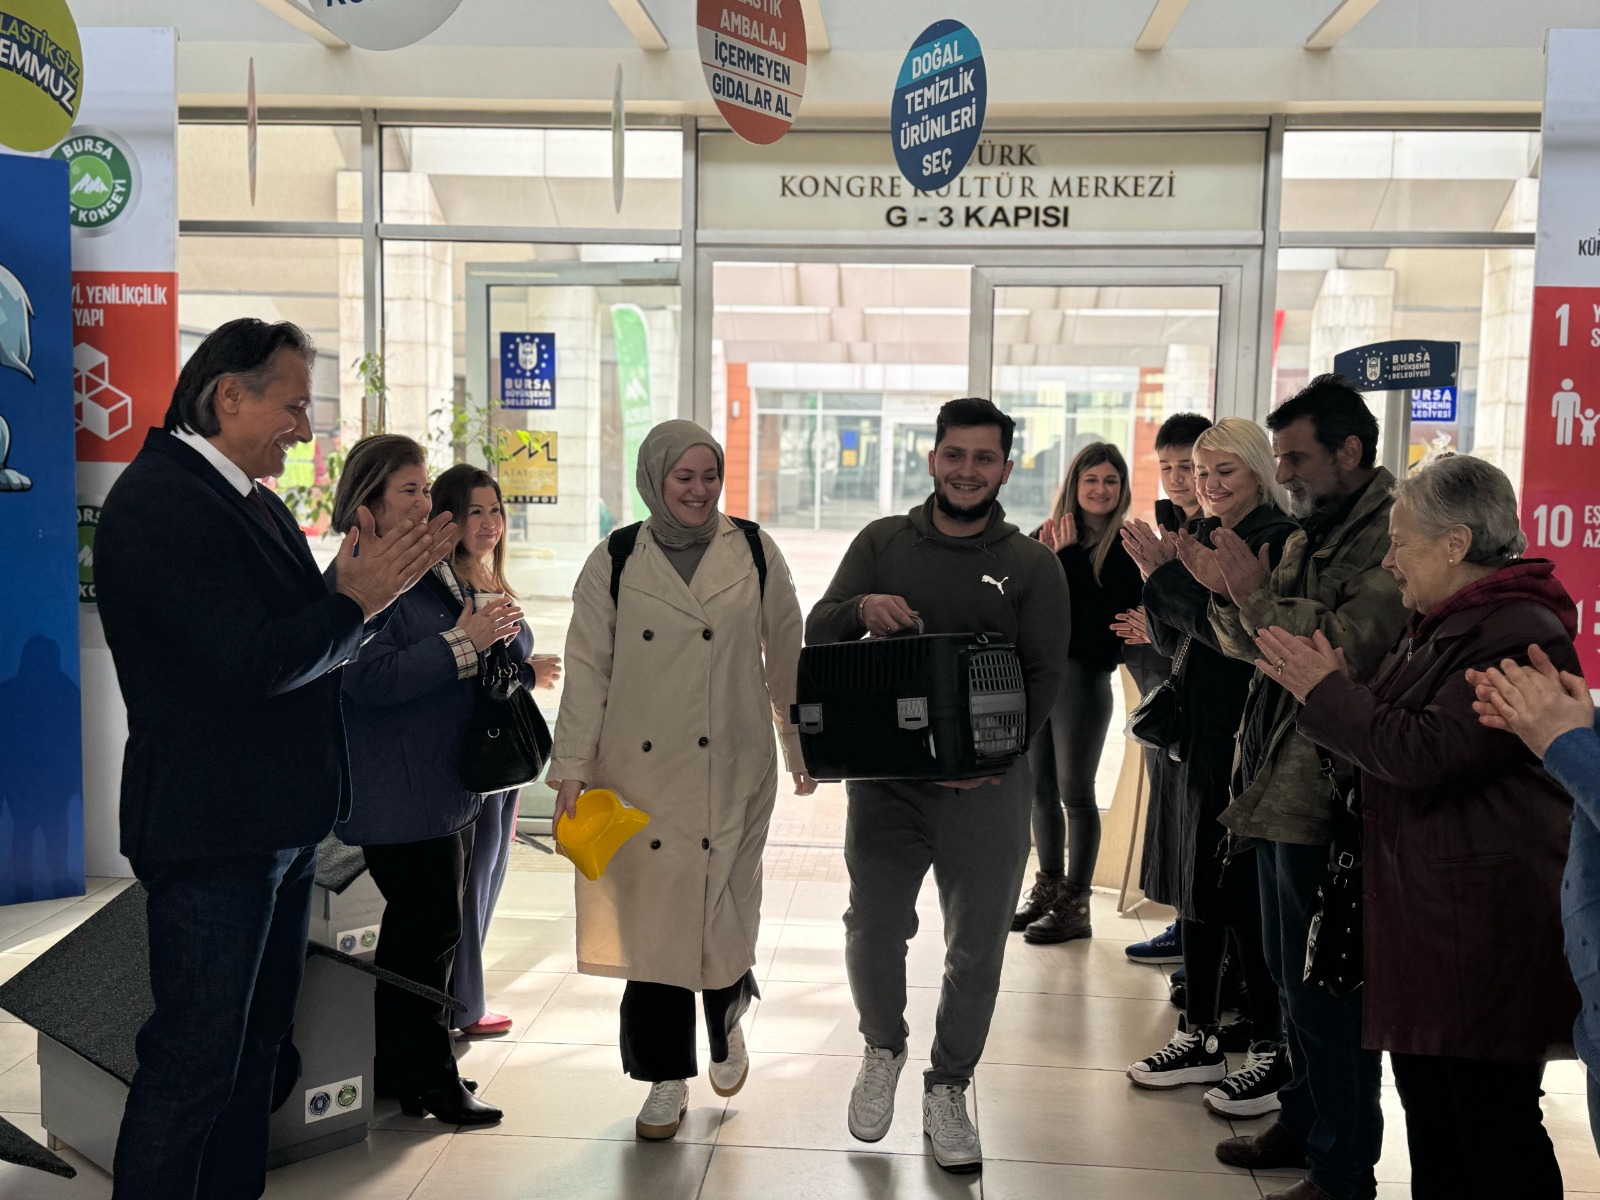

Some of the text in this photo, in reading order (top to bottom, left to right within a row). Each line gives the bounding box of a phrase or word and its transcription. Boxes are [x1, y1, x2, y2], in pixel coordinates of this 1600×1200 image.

[720, 8, 787, 52] AMBALAJ
[714, 32, 791, 85] İÇERMEYEN
[912, 40, 964, 80] DOĞAL
[712, 72, 792, 118] GIDALAR AL
[904, 66, 975, 115] TEMİZLİK
[900, 97, 976, 150] ÜRÜNLERİ
[61, 138, 113, 160] BURSA
[922, 147, 952, 177] SEÇ
[78, 179, 127, 222] KONSEYİ
[779, 175, 901, 198] KONGRE
[1048, 170, 1176, 198] MERKEZİ
[965, 206, 1070, 227] KAPISI
[86, 283, 167, 307] YENİLİKÇİLİK
[73, 308, 104, 327] YAPI
[1555, 304, 1570, 346] 1
[1392, 352, 1431, 364] BURSA
[1392, 371, 1431, 380] BELEDİYESİ
[505, 378, 551, 390] BURSA
[1534, 504, 1573, 548] 10
